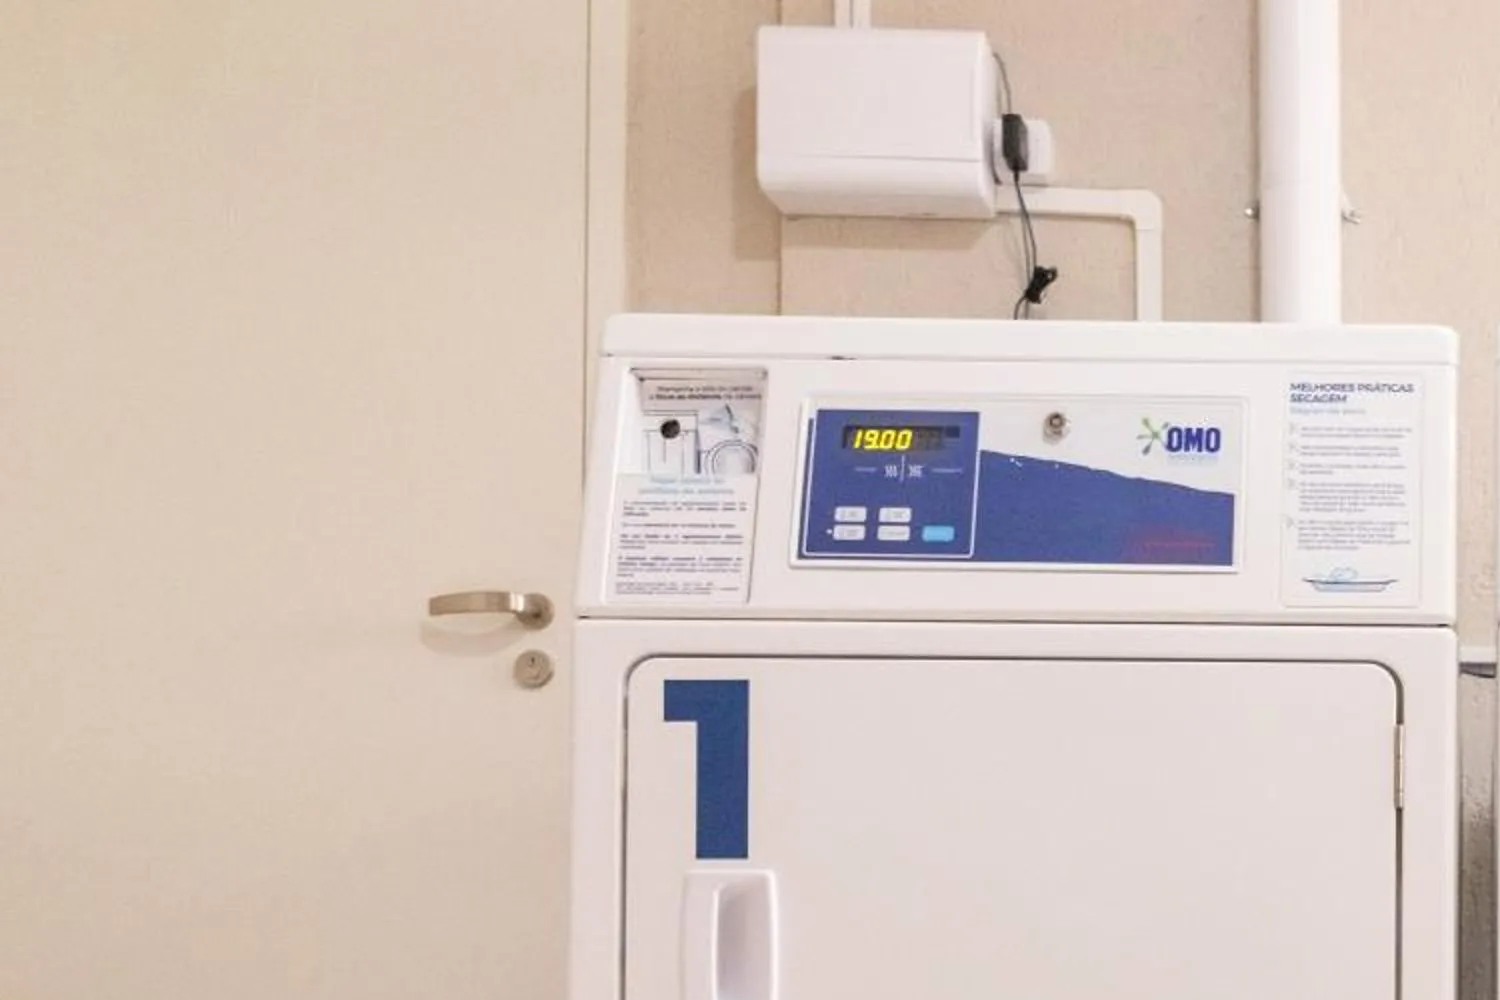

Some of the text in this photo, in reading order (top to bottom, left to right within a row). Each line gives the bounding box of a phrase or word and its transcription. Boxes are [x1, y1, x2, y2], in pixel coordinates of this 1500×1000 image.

[1290, 383, 1355, 392] MELHORES
[1290, 393, 1347, 403] SECAGEM
[1166, 427, 1221, 453] OMO
[664, 679, 749, 859] 1
